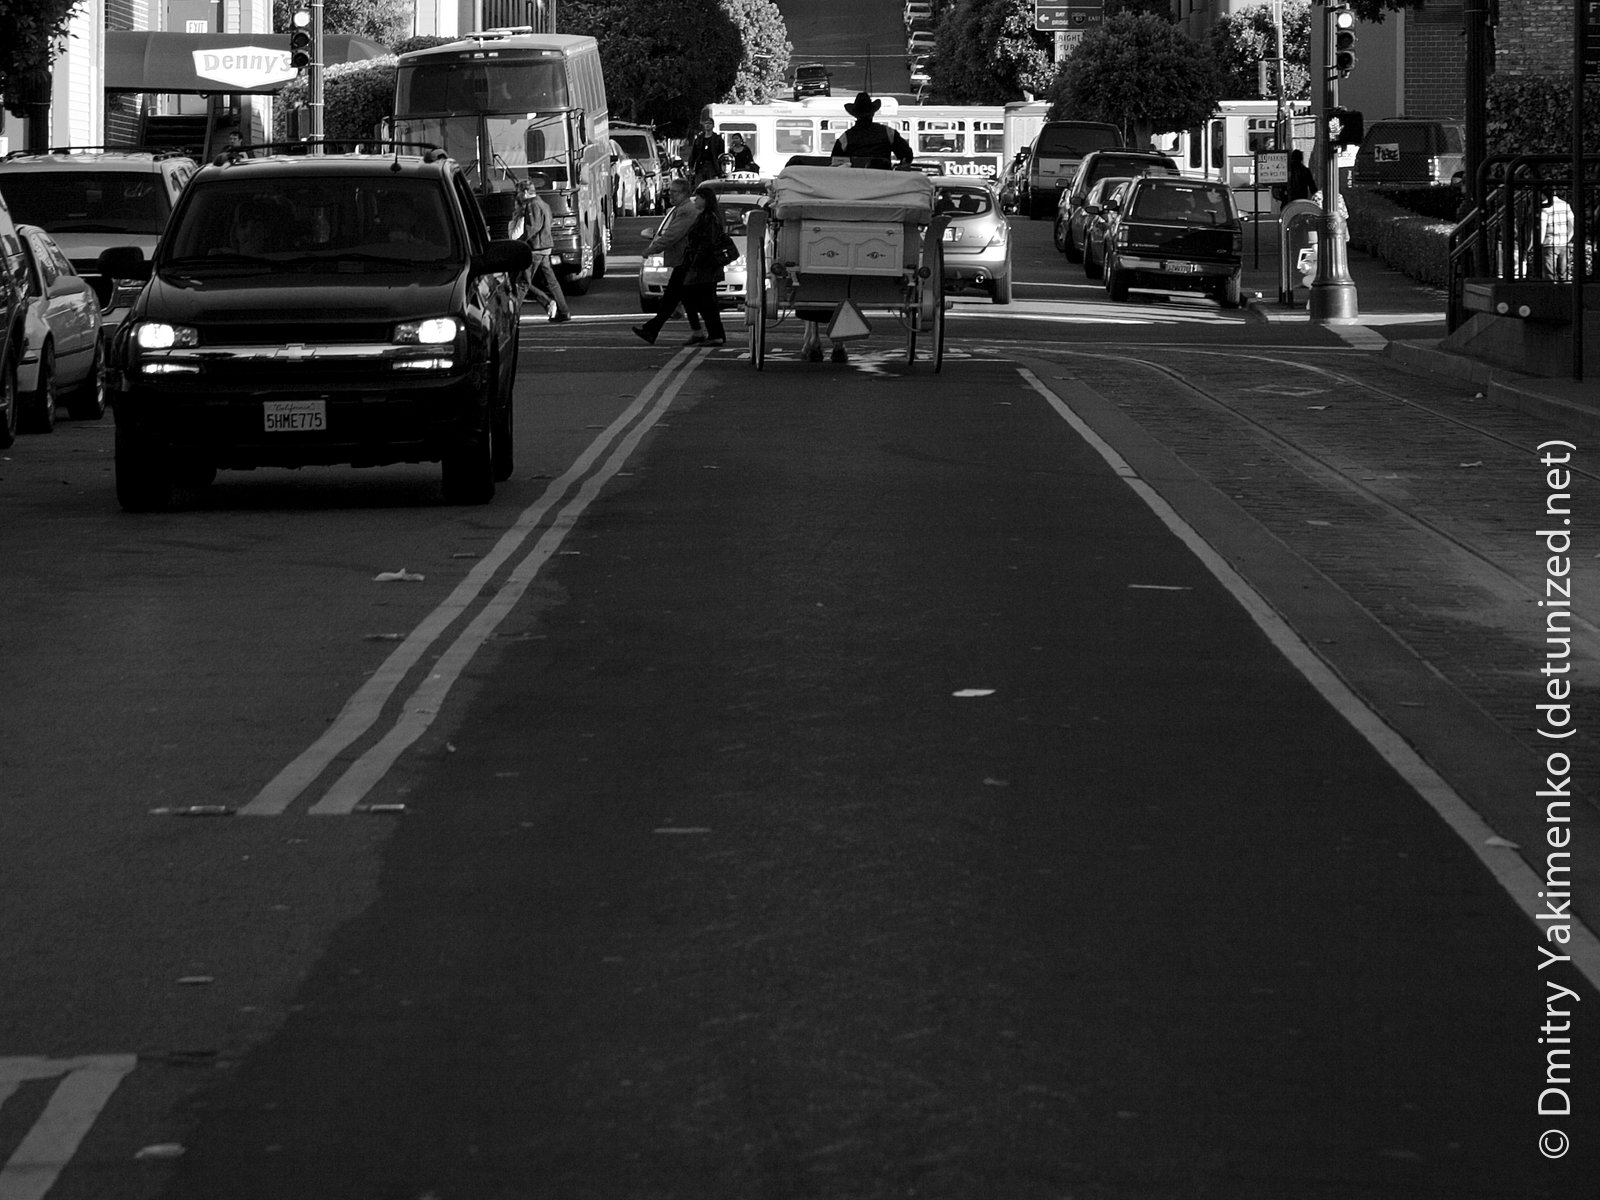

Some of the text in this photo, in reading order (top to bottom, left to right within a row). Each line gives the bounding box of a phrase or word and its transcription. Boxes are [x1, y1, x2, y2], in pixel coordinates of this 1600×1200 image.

[203, 54, 291, 73] Denny's
[944, 161, 995, 175] Forbes
[266, 413, 323, 429] 5HME775
